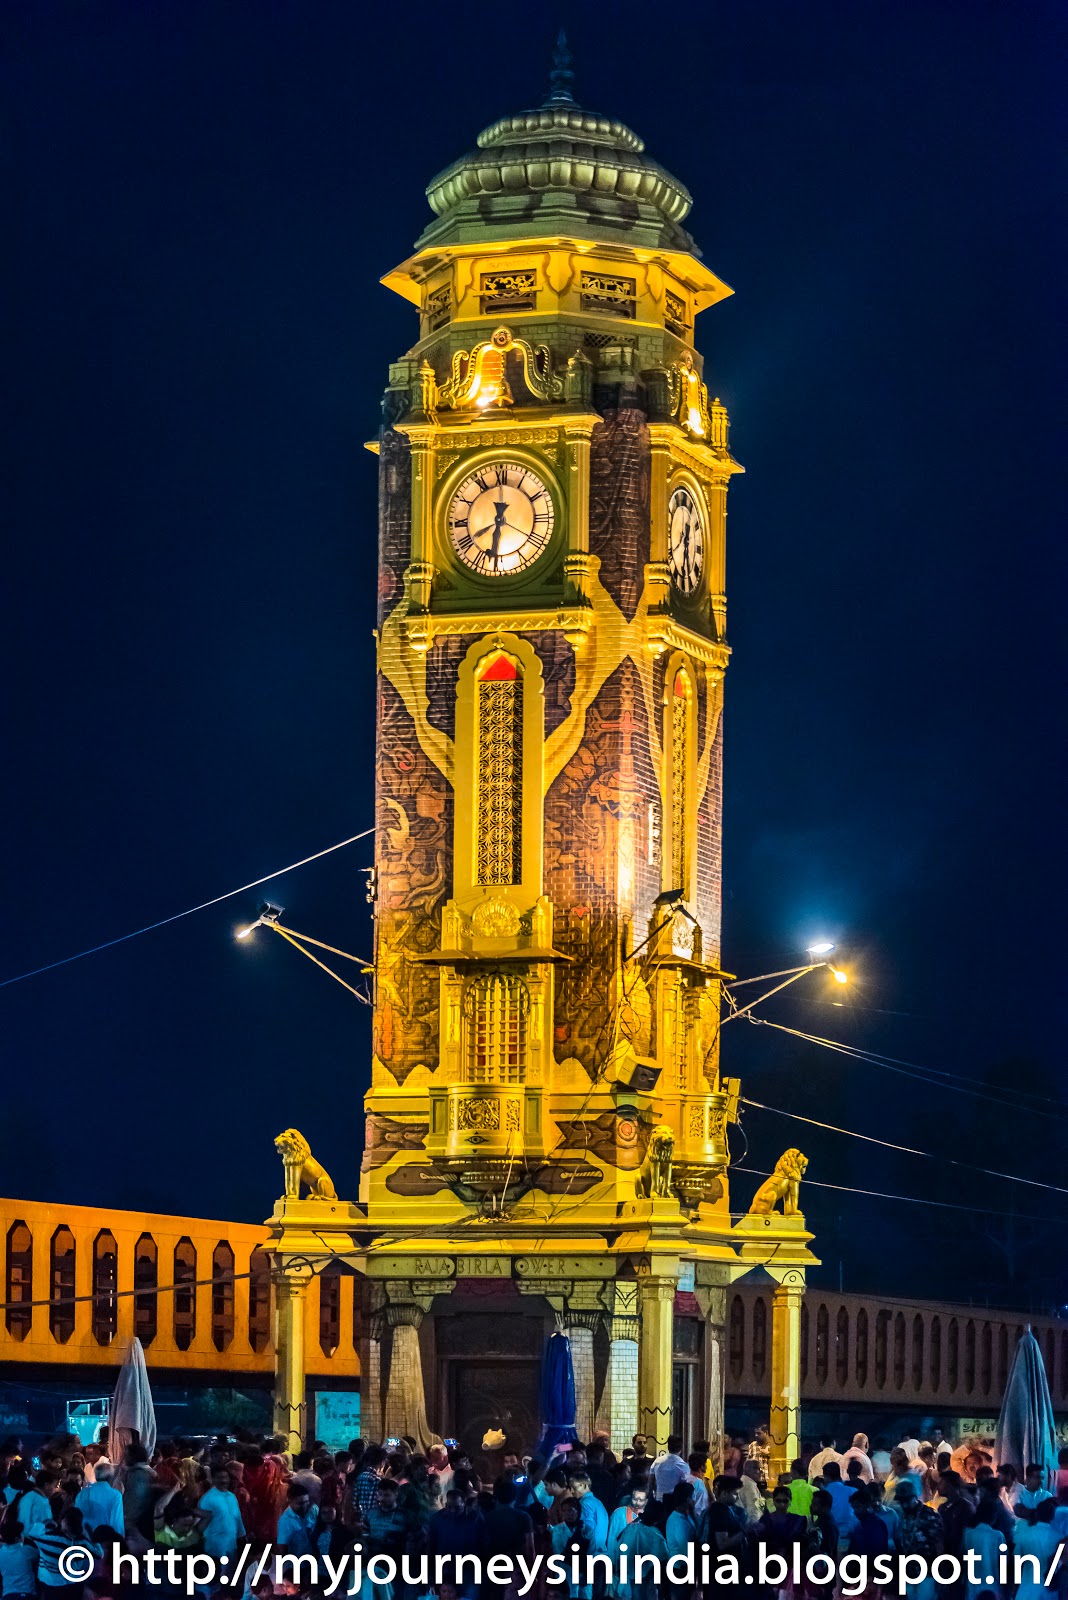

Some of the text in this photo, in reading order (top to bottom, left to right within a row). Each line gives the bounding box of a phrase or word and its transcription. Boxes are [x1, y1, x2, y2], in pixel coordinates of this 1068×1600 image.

[414, 1258, 565, 1275] RAJA BIRLA OWER
